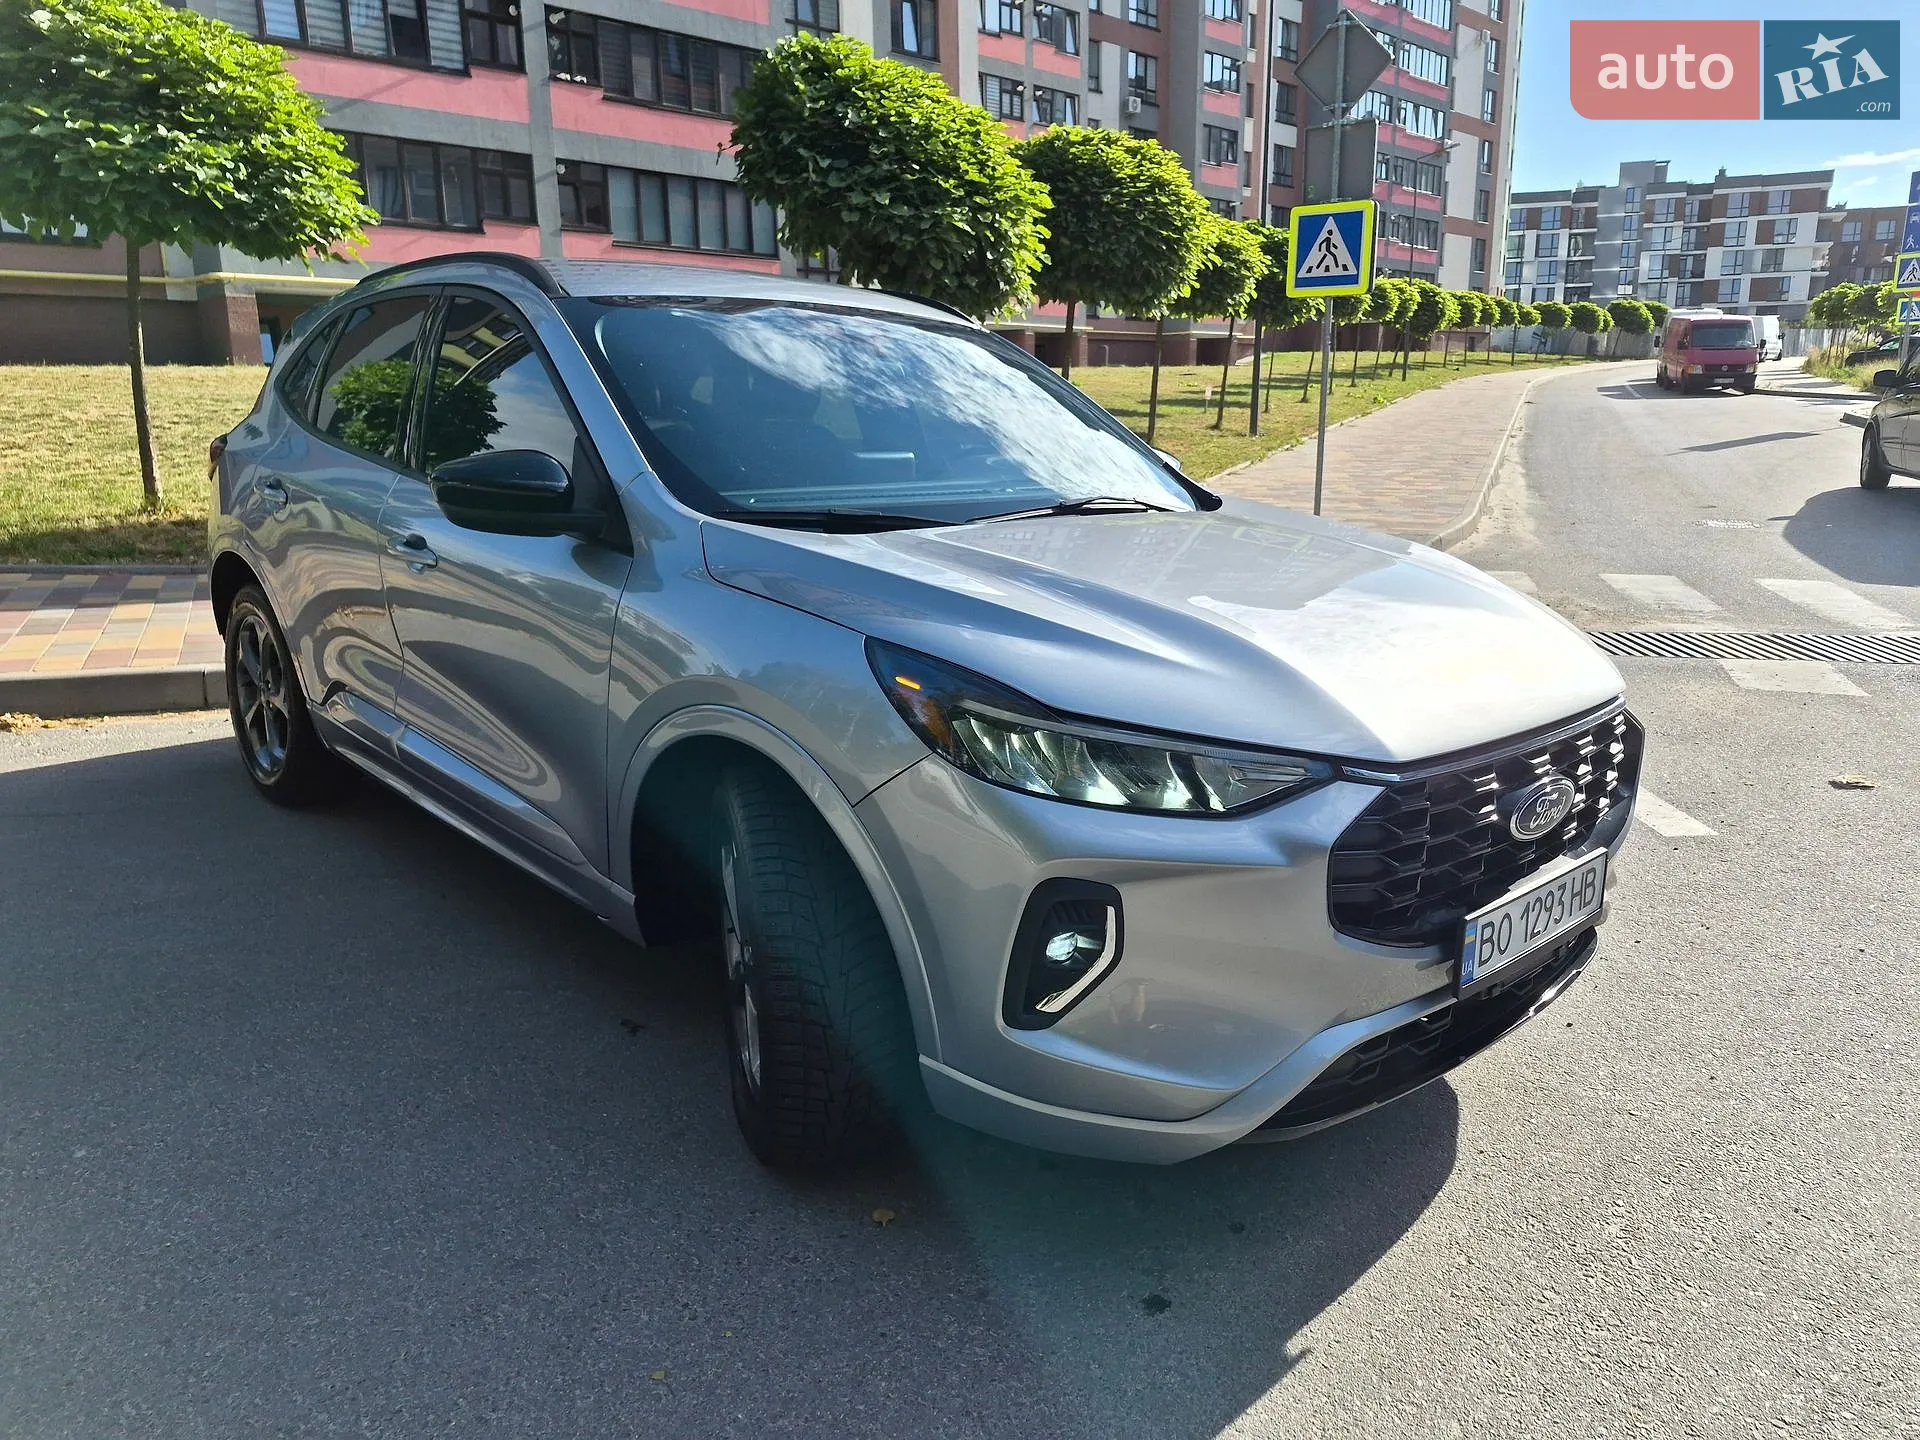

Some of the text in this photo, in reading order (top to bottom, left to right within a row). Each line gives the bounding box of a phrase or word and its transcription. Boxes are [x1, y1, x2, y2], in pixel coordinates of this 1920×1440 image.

[1529, 792, 1566, 829] Ford
[1478, 867, 1597, 968] BO 1293 HB
[1461, 959, 1473, 976] UA
